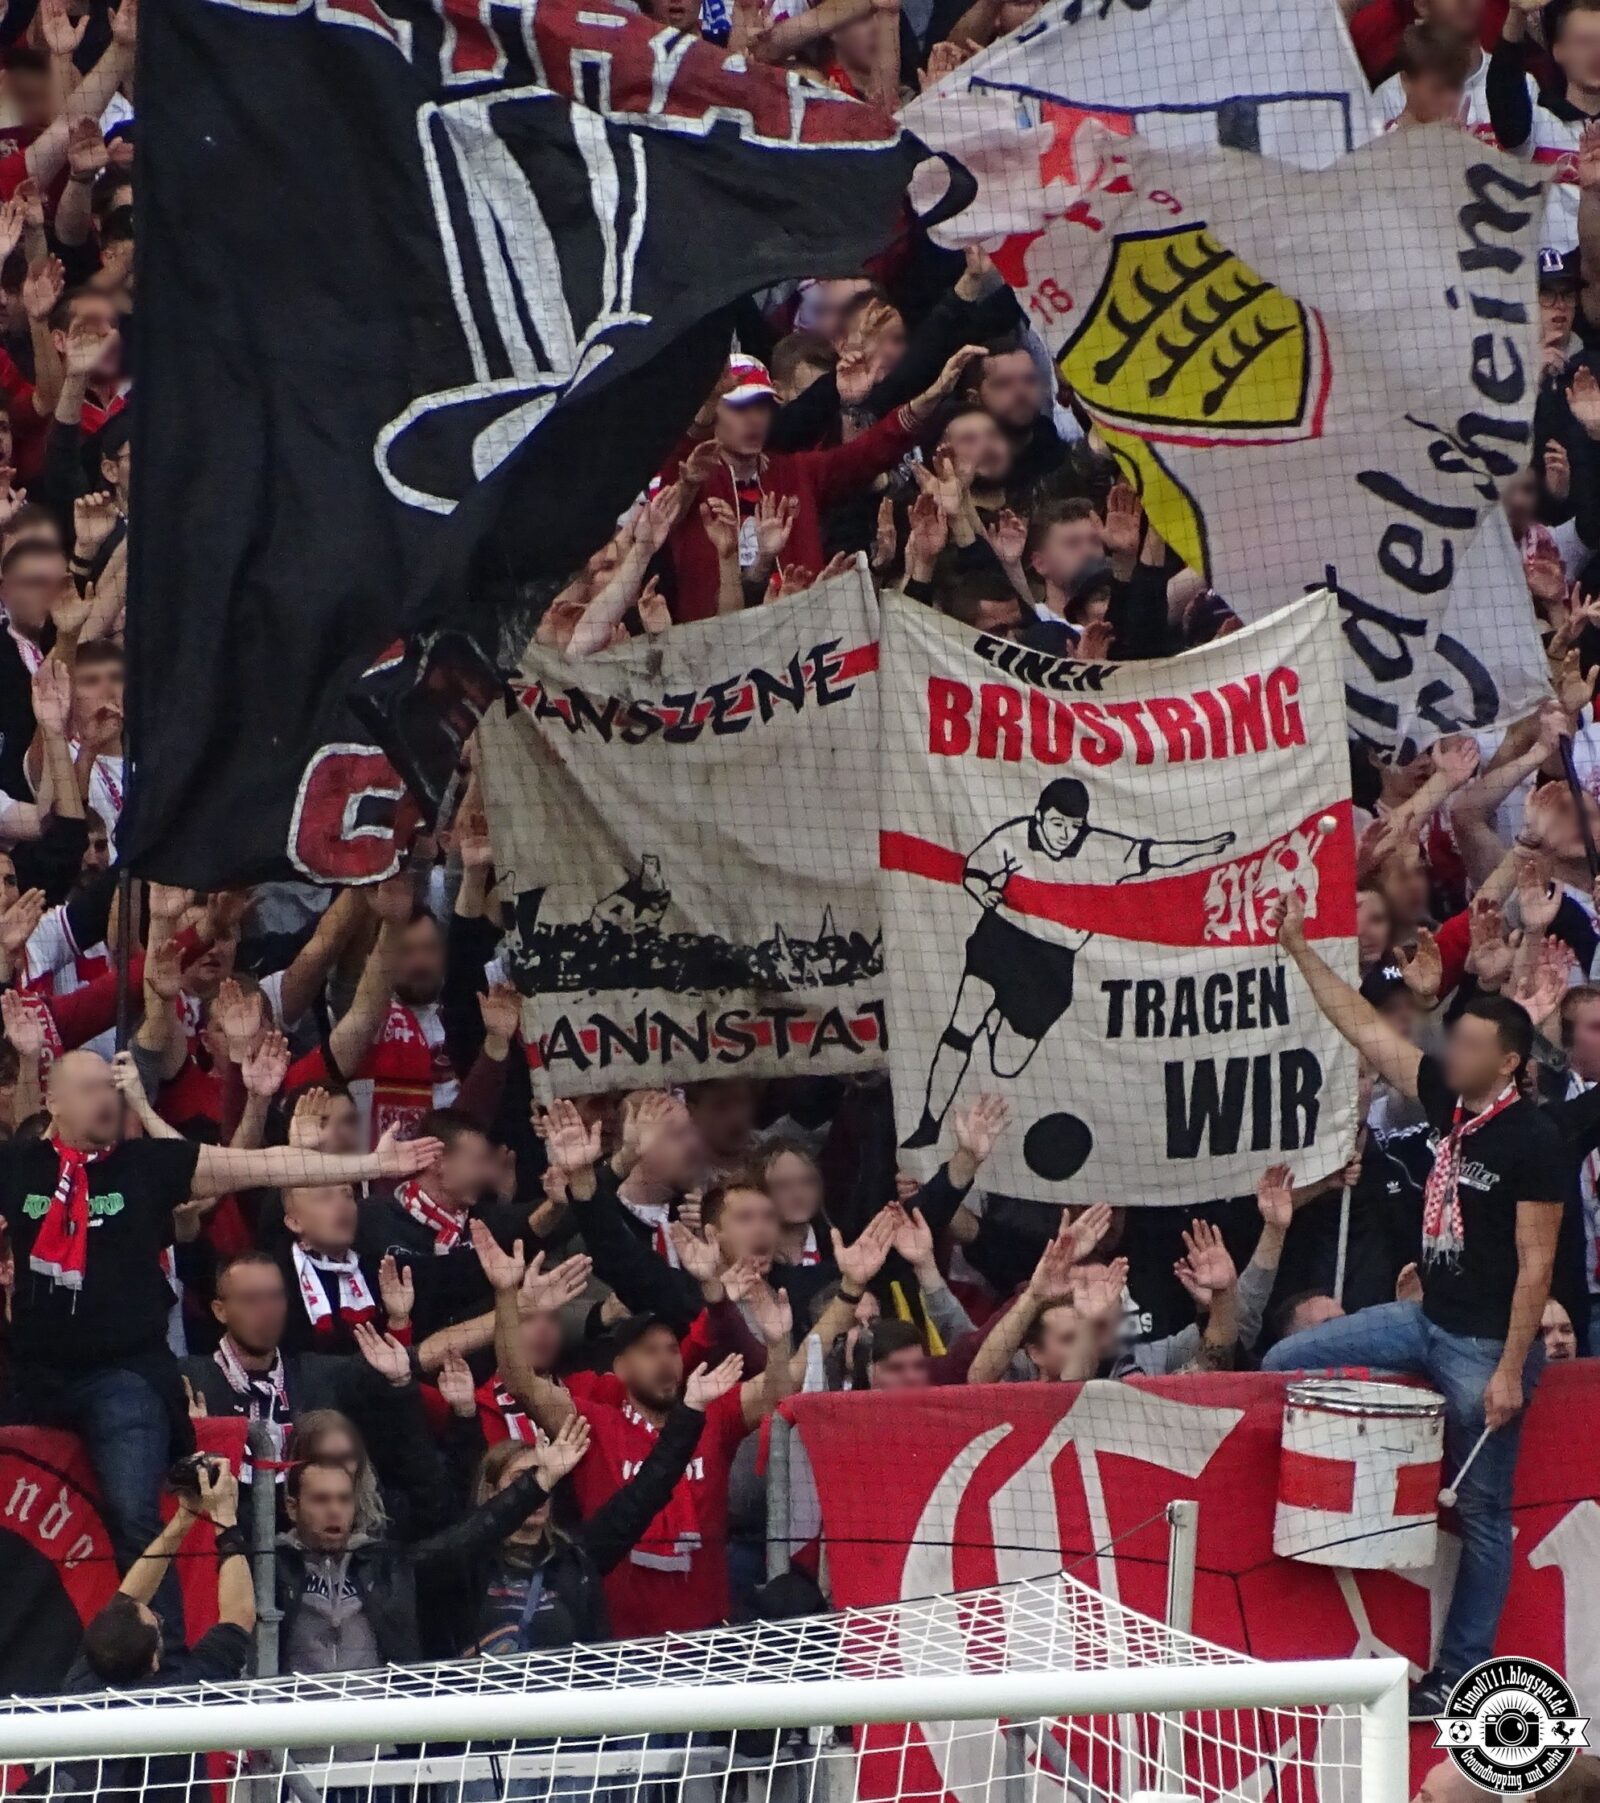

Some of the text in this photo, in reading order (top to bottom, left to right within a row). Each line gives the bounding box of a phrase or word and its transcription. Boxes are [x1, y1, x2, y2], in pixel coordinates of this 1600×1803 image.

[973, 633, 1119, 692] EINEN
[927, 665, 1307, 767] BRUSTRING
[541, 999, 889, 1072] ANNSTAT
[1100, 964, 1290, 1039] TRAGEN
[1164, 1047, 1323, 1160] WIR
